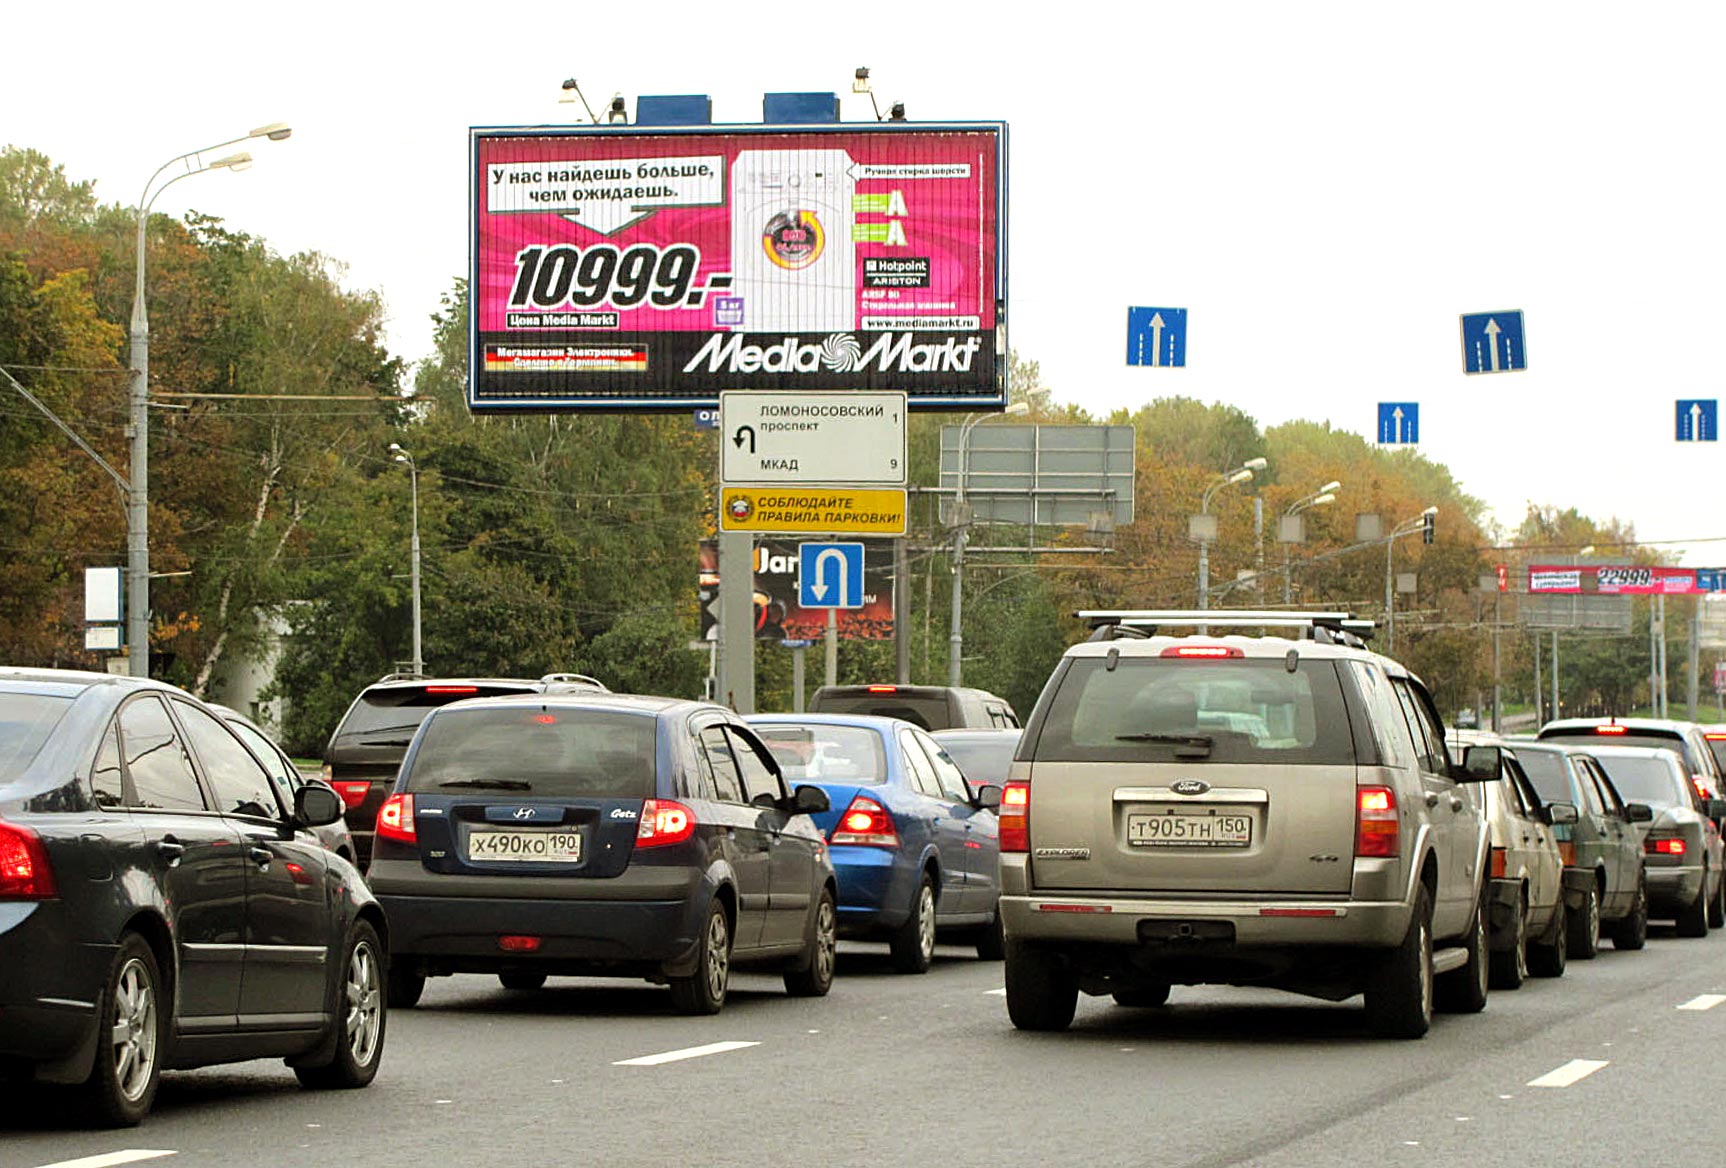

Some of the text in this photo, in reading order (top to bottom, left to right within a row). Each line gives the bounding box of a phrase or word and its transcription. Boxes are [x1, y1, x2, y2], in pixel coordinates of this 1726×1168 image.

[493, 163, 714, 185] У нас найдешь больше,
[529, 186, 678, 202] чем ожидаешь.
[879, 261, 927, 272] Hotpoint
[872, 277, 921, 285] ARISTON
[543, 314, 577, 325] Media
[580, 315, 614, 325] Markt
[867, 318, 973, 328] www.mediamarkt.ru
[683, 333, 980, 373] Media Markt
[760, 405, 898, 424] ЛОМОНОСОВСКИЙ 1
[761, 422, 819, 432] проспект
[761, 459, 898, 471] МКАД 9
[758, 497, 853, 509] СОБЛЮДАЙТЕ
[757, 511, 900, 524] ПРАВИЛА ПАРКОВКИ!
[1178, 781, 1200, 792] Ford
[610, 809, 637, 819] Getz
[1216, 818, 1244, 832] 150
[550, 835, 575, 848] 190
